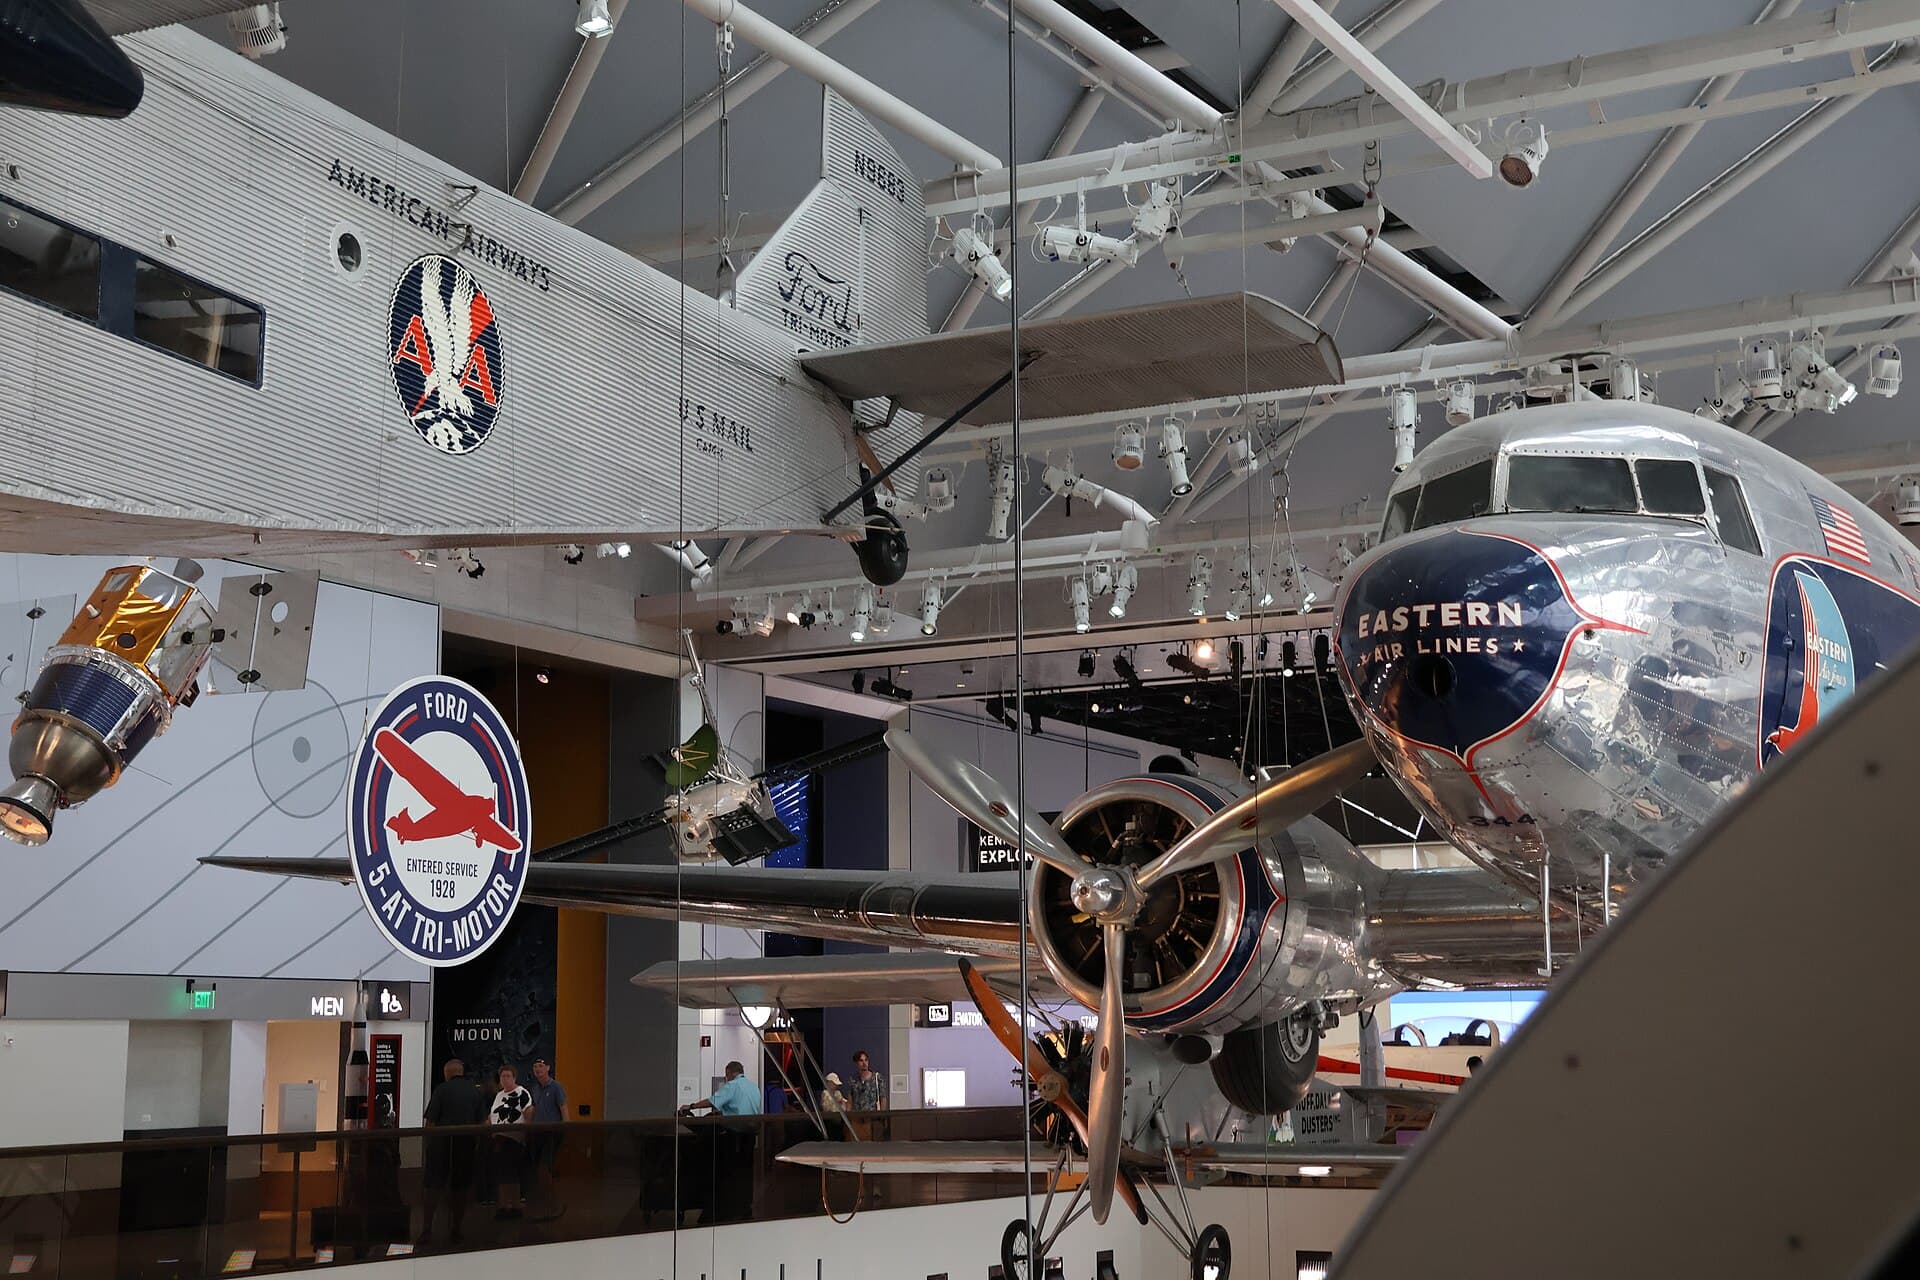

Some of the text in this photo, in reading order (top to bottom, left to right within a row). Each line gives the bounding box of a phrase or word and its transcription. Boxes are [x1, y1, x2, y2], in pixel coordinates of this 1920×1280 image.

[328, 158, 551, 292] AMERICAN AIRWAYS
[778, 252, 851, 333] Ford
[712, 412, 754, 454] MAIL
[1358, 602, 1523, 639] EASTERN
[1374, 637, 1499, 663] AIR LINES
[1807, 631, 1847, 664] EASTERN
[424, 692, 468, 723] FORD
[1468, 813, 1538, 827] 344
[980, 835, 1006, 847] KEN
[406, 858, 478, 878] ENTERED SERVICE
[430, 879, 456, 899] 1928
[368, 861, 514, 953] 5-AT TRI-MOTOR
[311, 996, 344, 1016] MEN
[454, 1028, 502, 1041] MOON
[1301, 1115, 1334, 1135] DUSTERS
